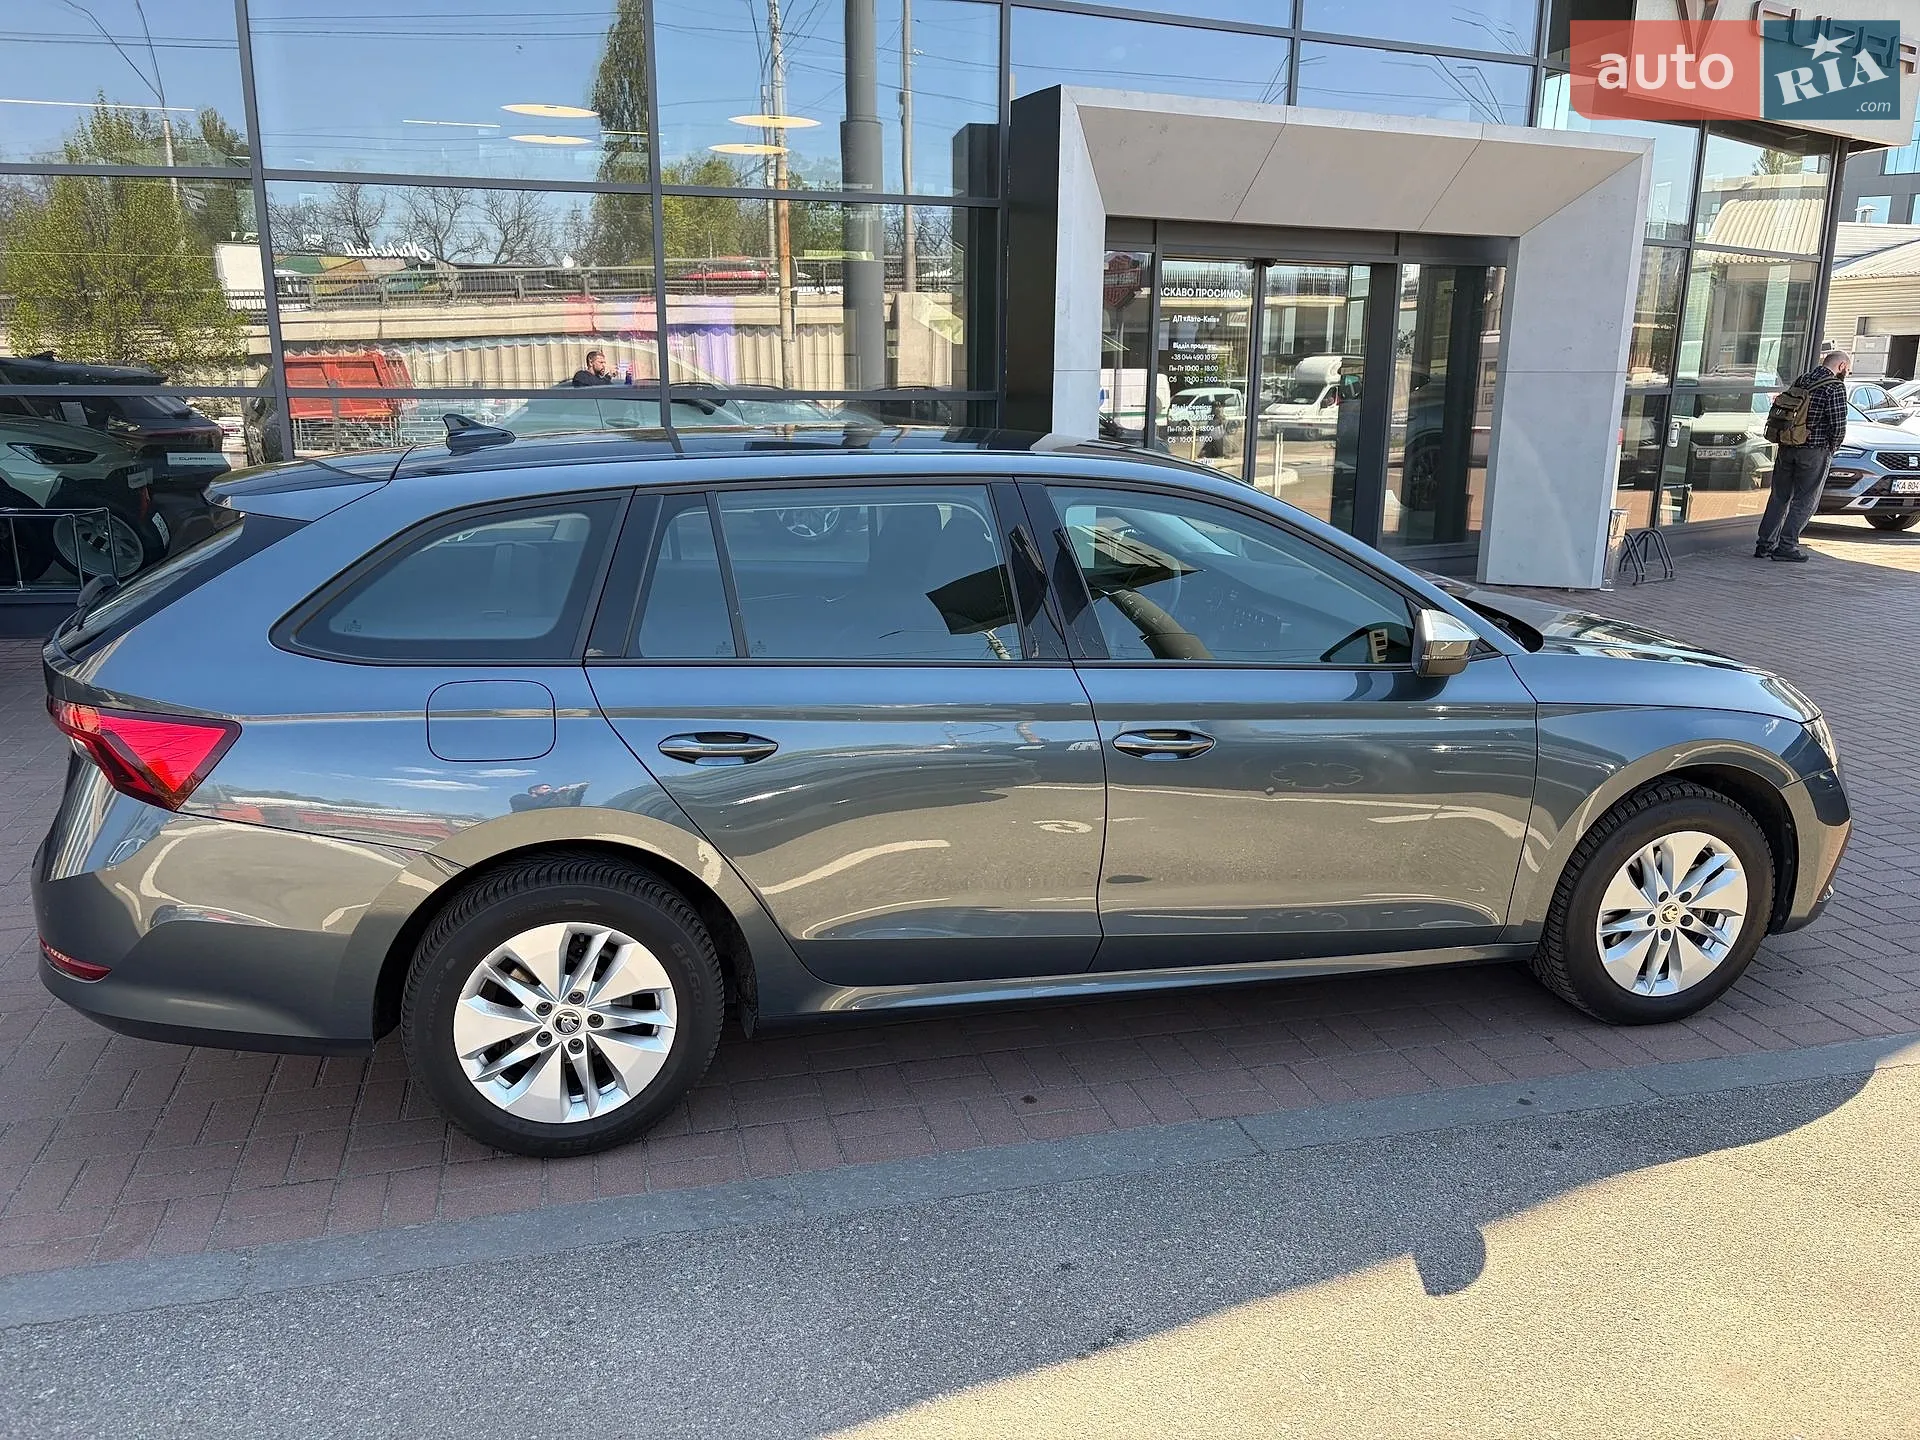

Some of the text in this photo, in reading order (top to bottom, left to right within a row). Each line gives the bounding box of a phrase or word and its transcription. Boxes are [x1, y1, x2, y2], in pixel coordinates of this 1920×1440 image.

[1193, 353, 1204, 361] 490
[1184, 364, 1200, 372] 10:00
[1184, 375, 1200, 383] 10:00
[1204, 375, 1218, 383] 17:00
